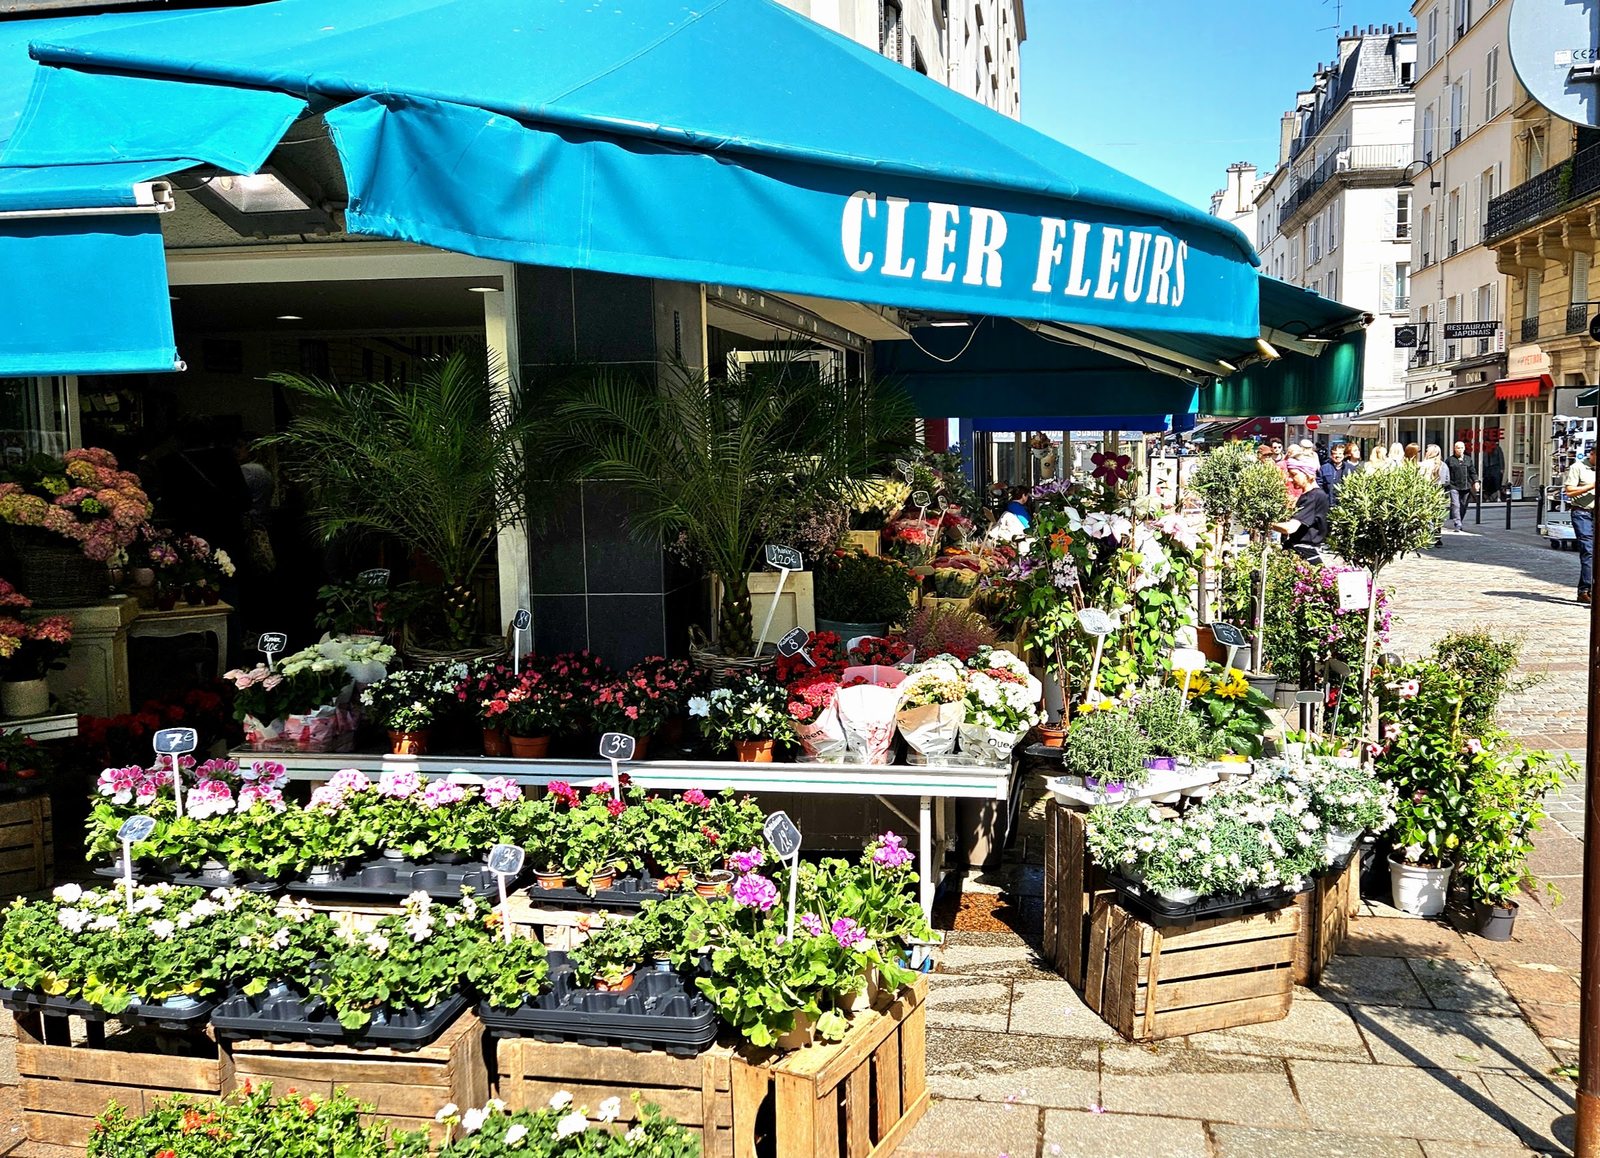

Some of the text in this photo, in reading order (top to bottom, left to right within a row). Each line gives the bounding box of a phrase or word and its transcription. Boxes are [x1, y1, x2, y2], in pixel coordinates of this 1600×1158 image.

[841, 190, 1188, 308] CLER FLEURS
[1446, 322, 1496, 332] RESTAURANT
[1452, 329, 1491, 337] JAPONAIS
[1457, 428, 1505, 441] COFFEE
[772, 554, 797, 565] 120€
[517, 611, 530, 627] 8€
[1223, 629, 1237, 642] 5€
[264, 642, 279, 651] 10€
[788, 638, 799, 650] 8
[166, 731, 194, 751] 7€
[608, 735, 628, 754] 3€
[499, 848, 516, 866] 3€
